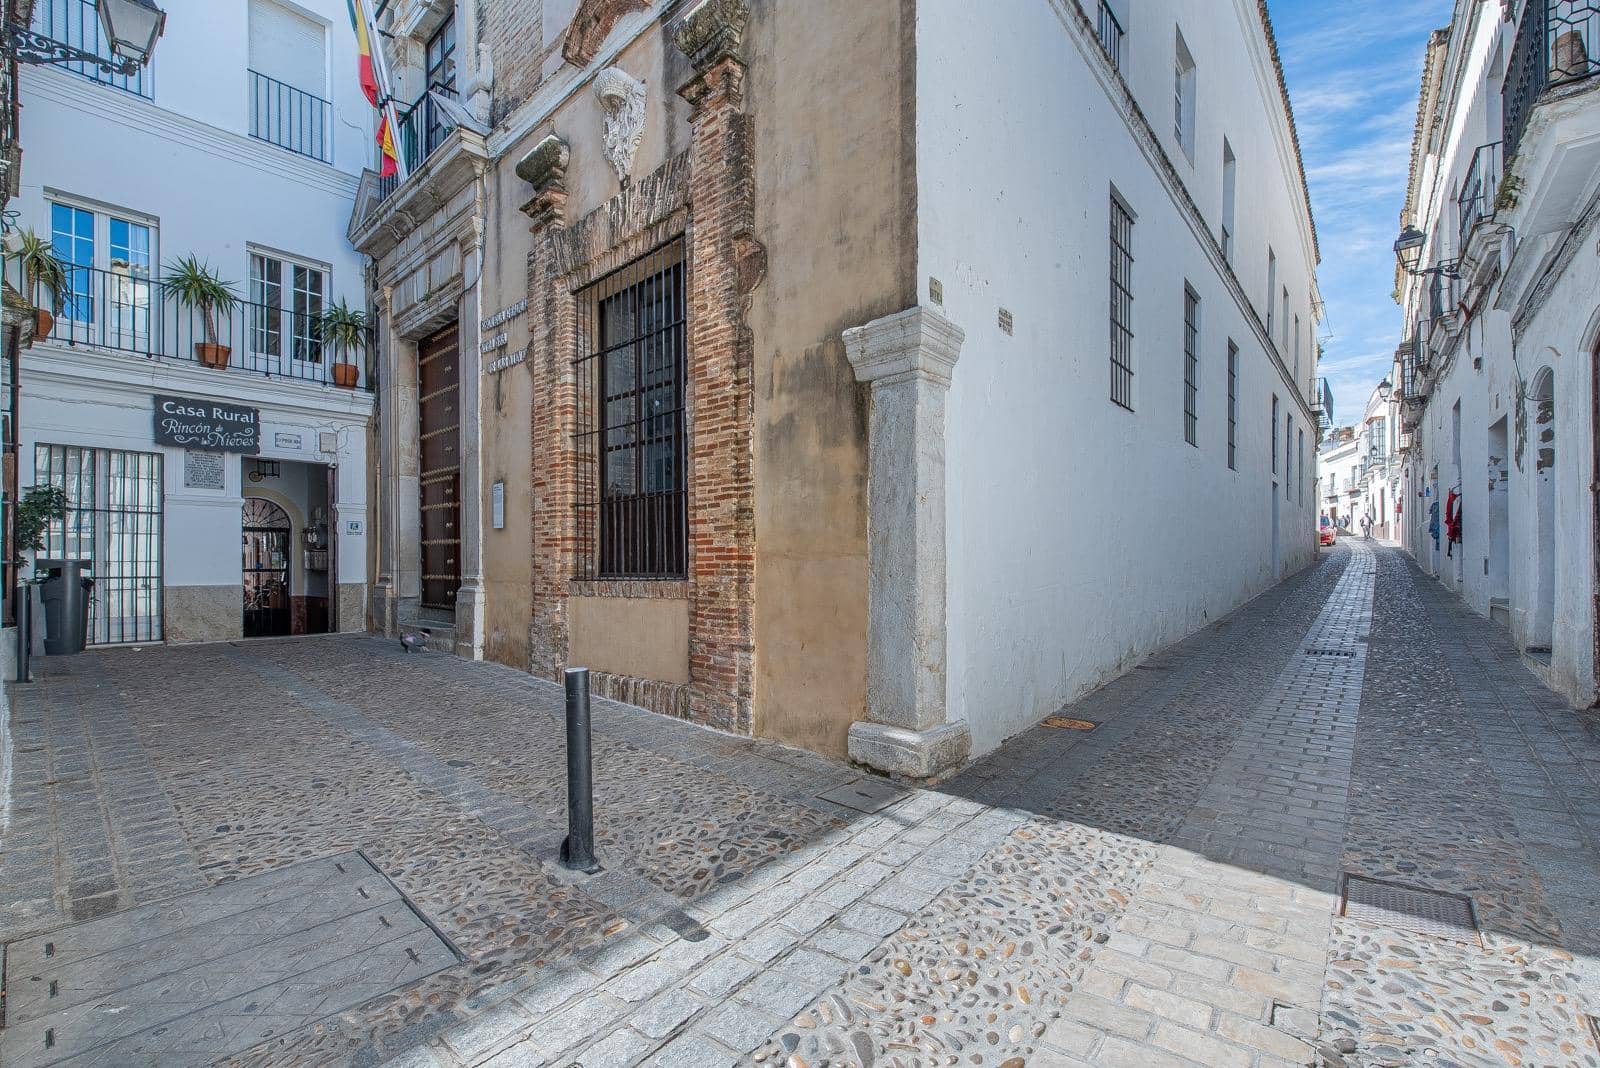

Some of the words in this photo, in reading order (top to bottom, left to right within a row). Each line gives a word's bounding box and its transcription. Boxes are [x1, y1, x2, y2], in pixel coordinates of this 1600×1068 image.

[162, 401, 206, 417] Casa
[212, 407, 254, 423] Rural
[161, 418, 210, 434] Rincón
[214, 424, 223, 433] de
[207, 431, 254, 447] Nieves
